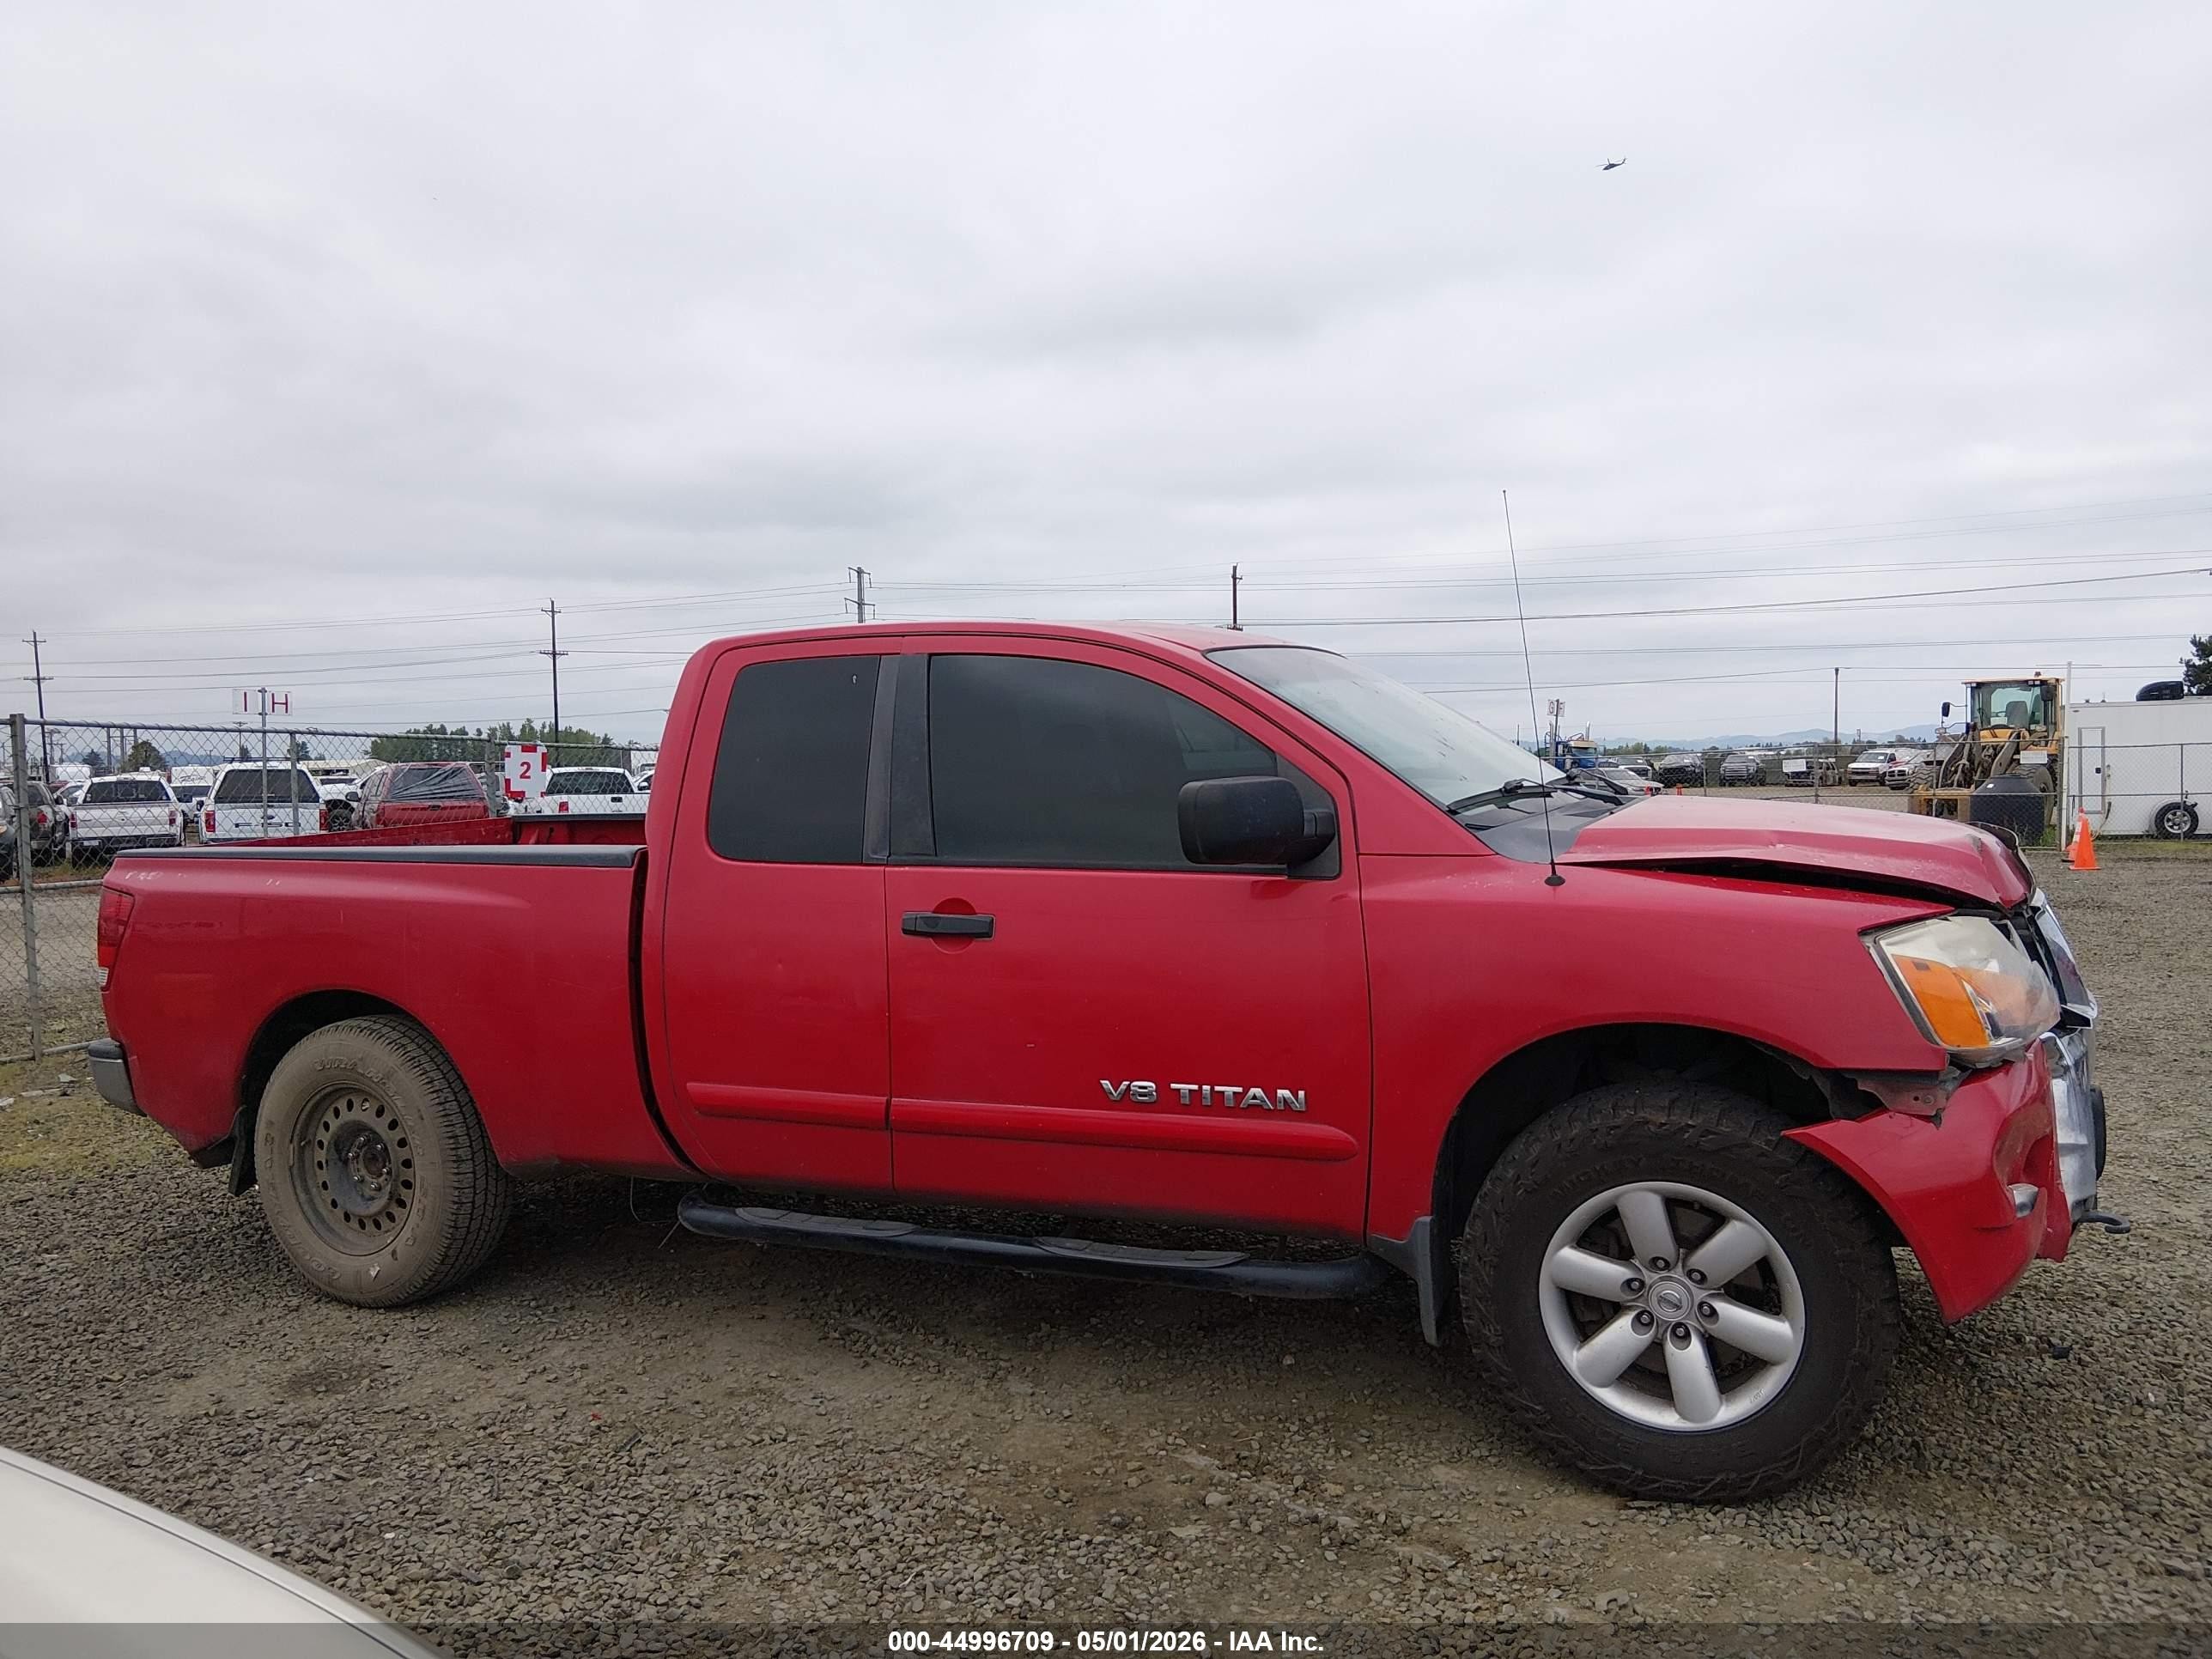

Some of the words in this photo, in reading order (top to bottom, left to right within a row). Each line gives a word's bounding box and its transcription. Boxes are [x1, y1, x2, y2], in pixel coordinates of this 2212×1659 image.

[271, 692, 289, 714] H
[1548, 701, 1554, 714] G
[1559, 702, 1564, 714] F
[520, 761, 532, 779] 2
[1100, 1080, 1157, 1103] V8
[1170, 1083, 1306, 1111] TITAN
